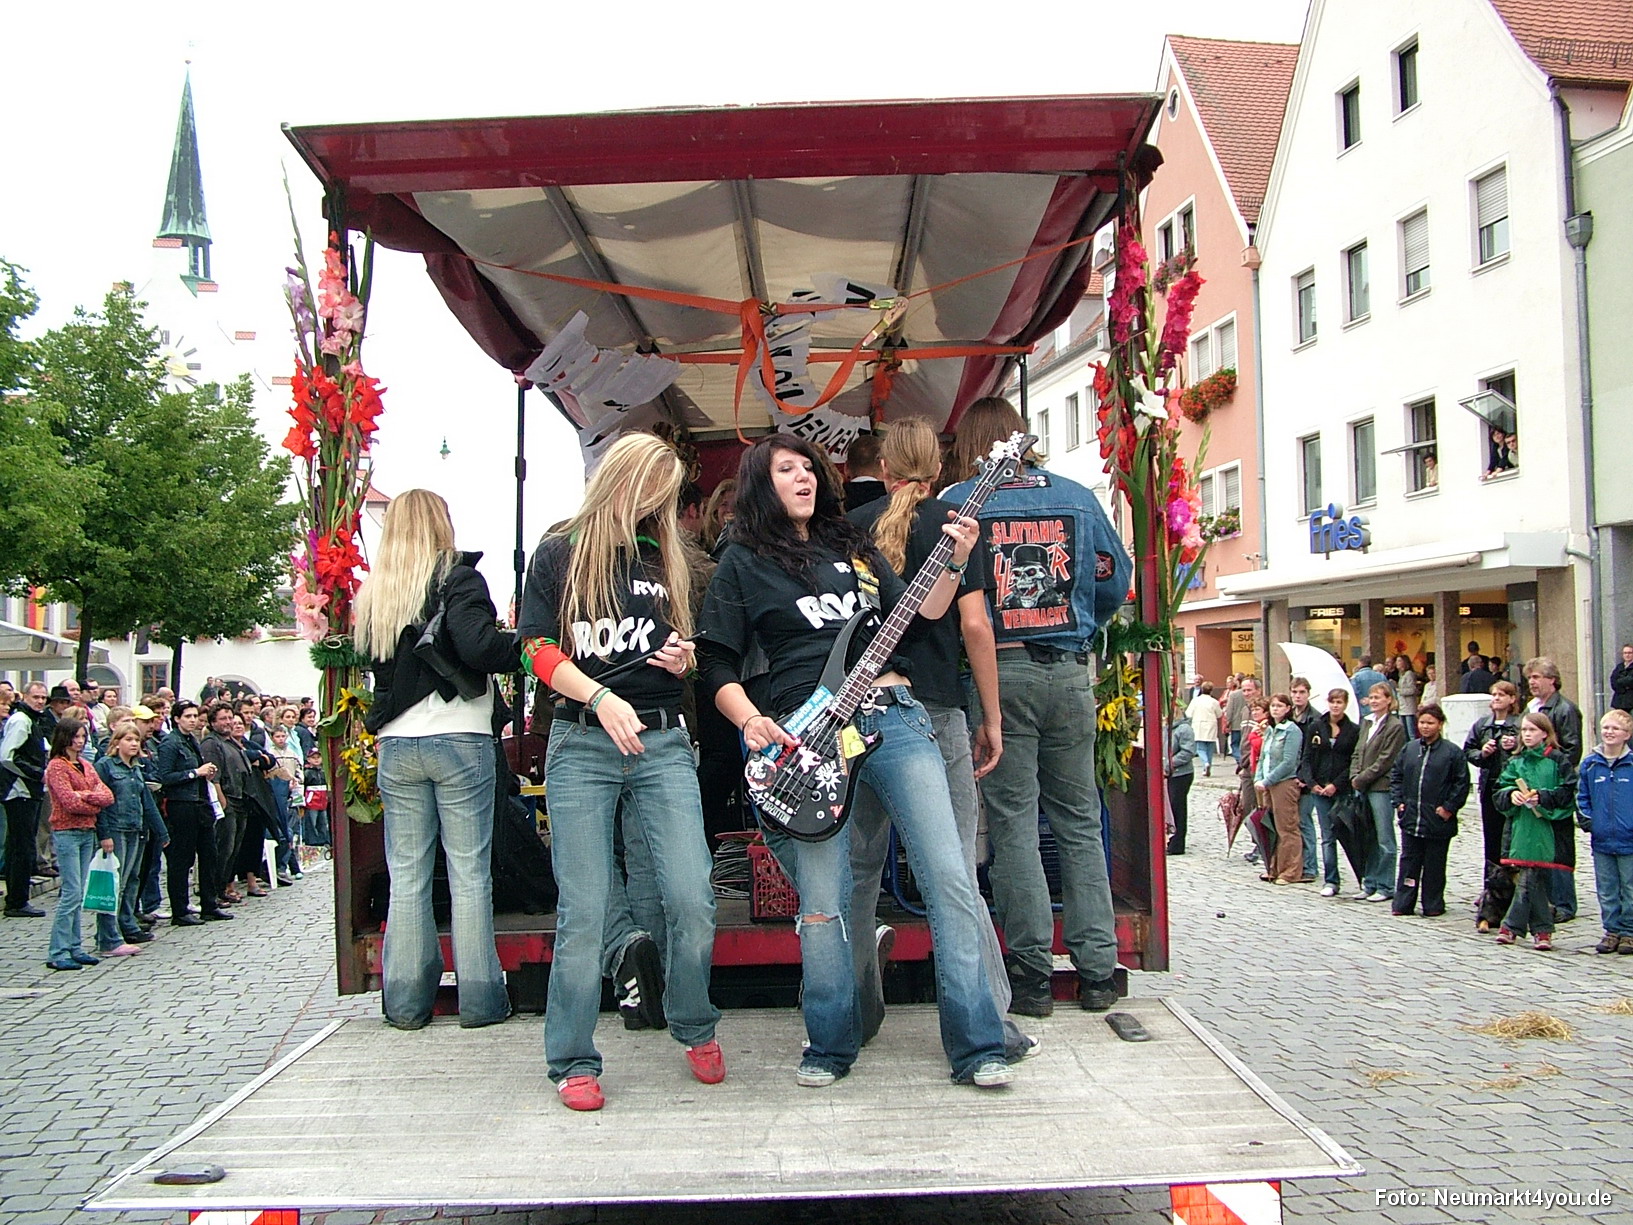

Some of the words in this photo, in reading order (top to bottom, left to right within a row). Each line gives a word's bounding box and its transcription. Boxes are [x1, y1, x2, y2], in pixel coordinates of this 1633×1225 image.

[992, 519, 1065, 544] SLAYTANIC
[1310, 503, 1366, 554] Fries
[1002, 605, 1069, 629] WEHRMACHT
[1310, 607, 1345, 617] FRIES
[1384, 606, 1424, 616] SCHUH
[572, 616, 656, 660] ROCK
